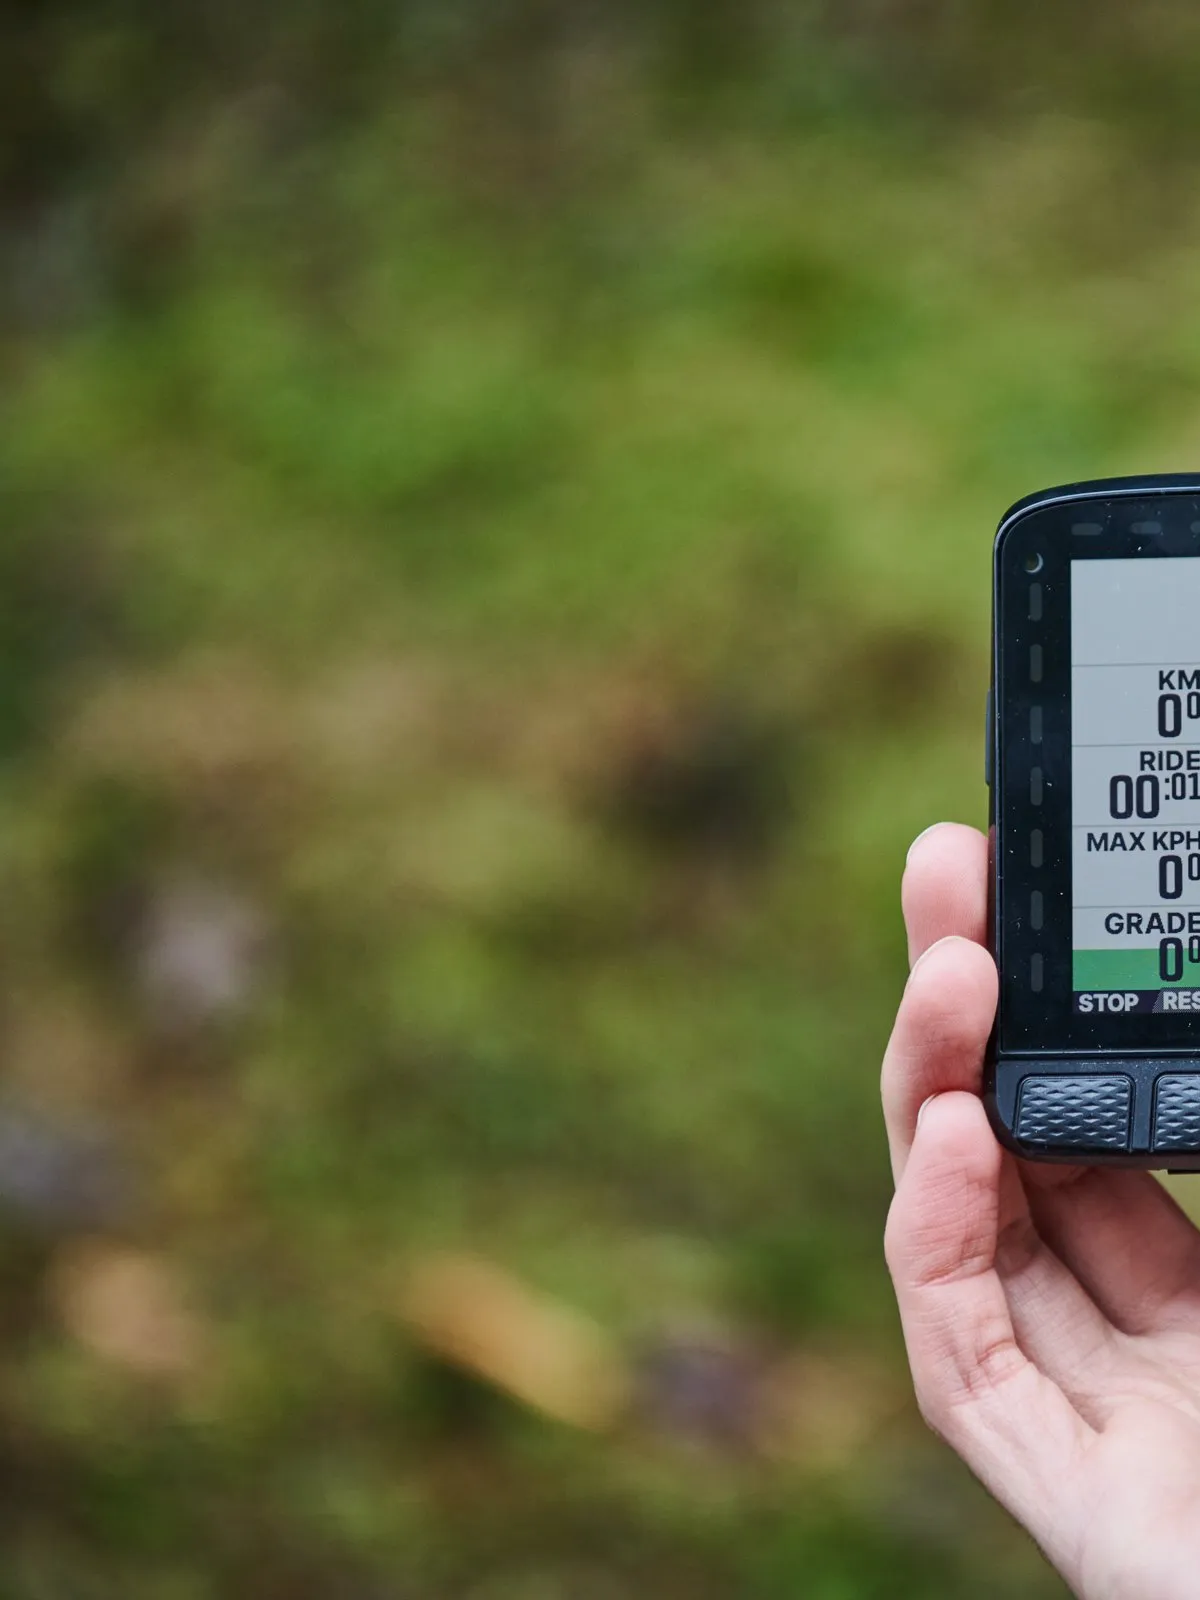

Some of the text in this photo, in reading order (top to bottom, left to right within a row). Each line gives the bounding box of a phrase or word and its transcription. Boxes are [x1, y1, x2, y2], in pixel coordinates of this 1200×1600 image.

[1158, 670, 1200, 690] KM
[1140, 751, 1200, 770] RIDE
[1087, 832, 1145, 852] MAX
[1078, 993, 1138, 1012] STOP
